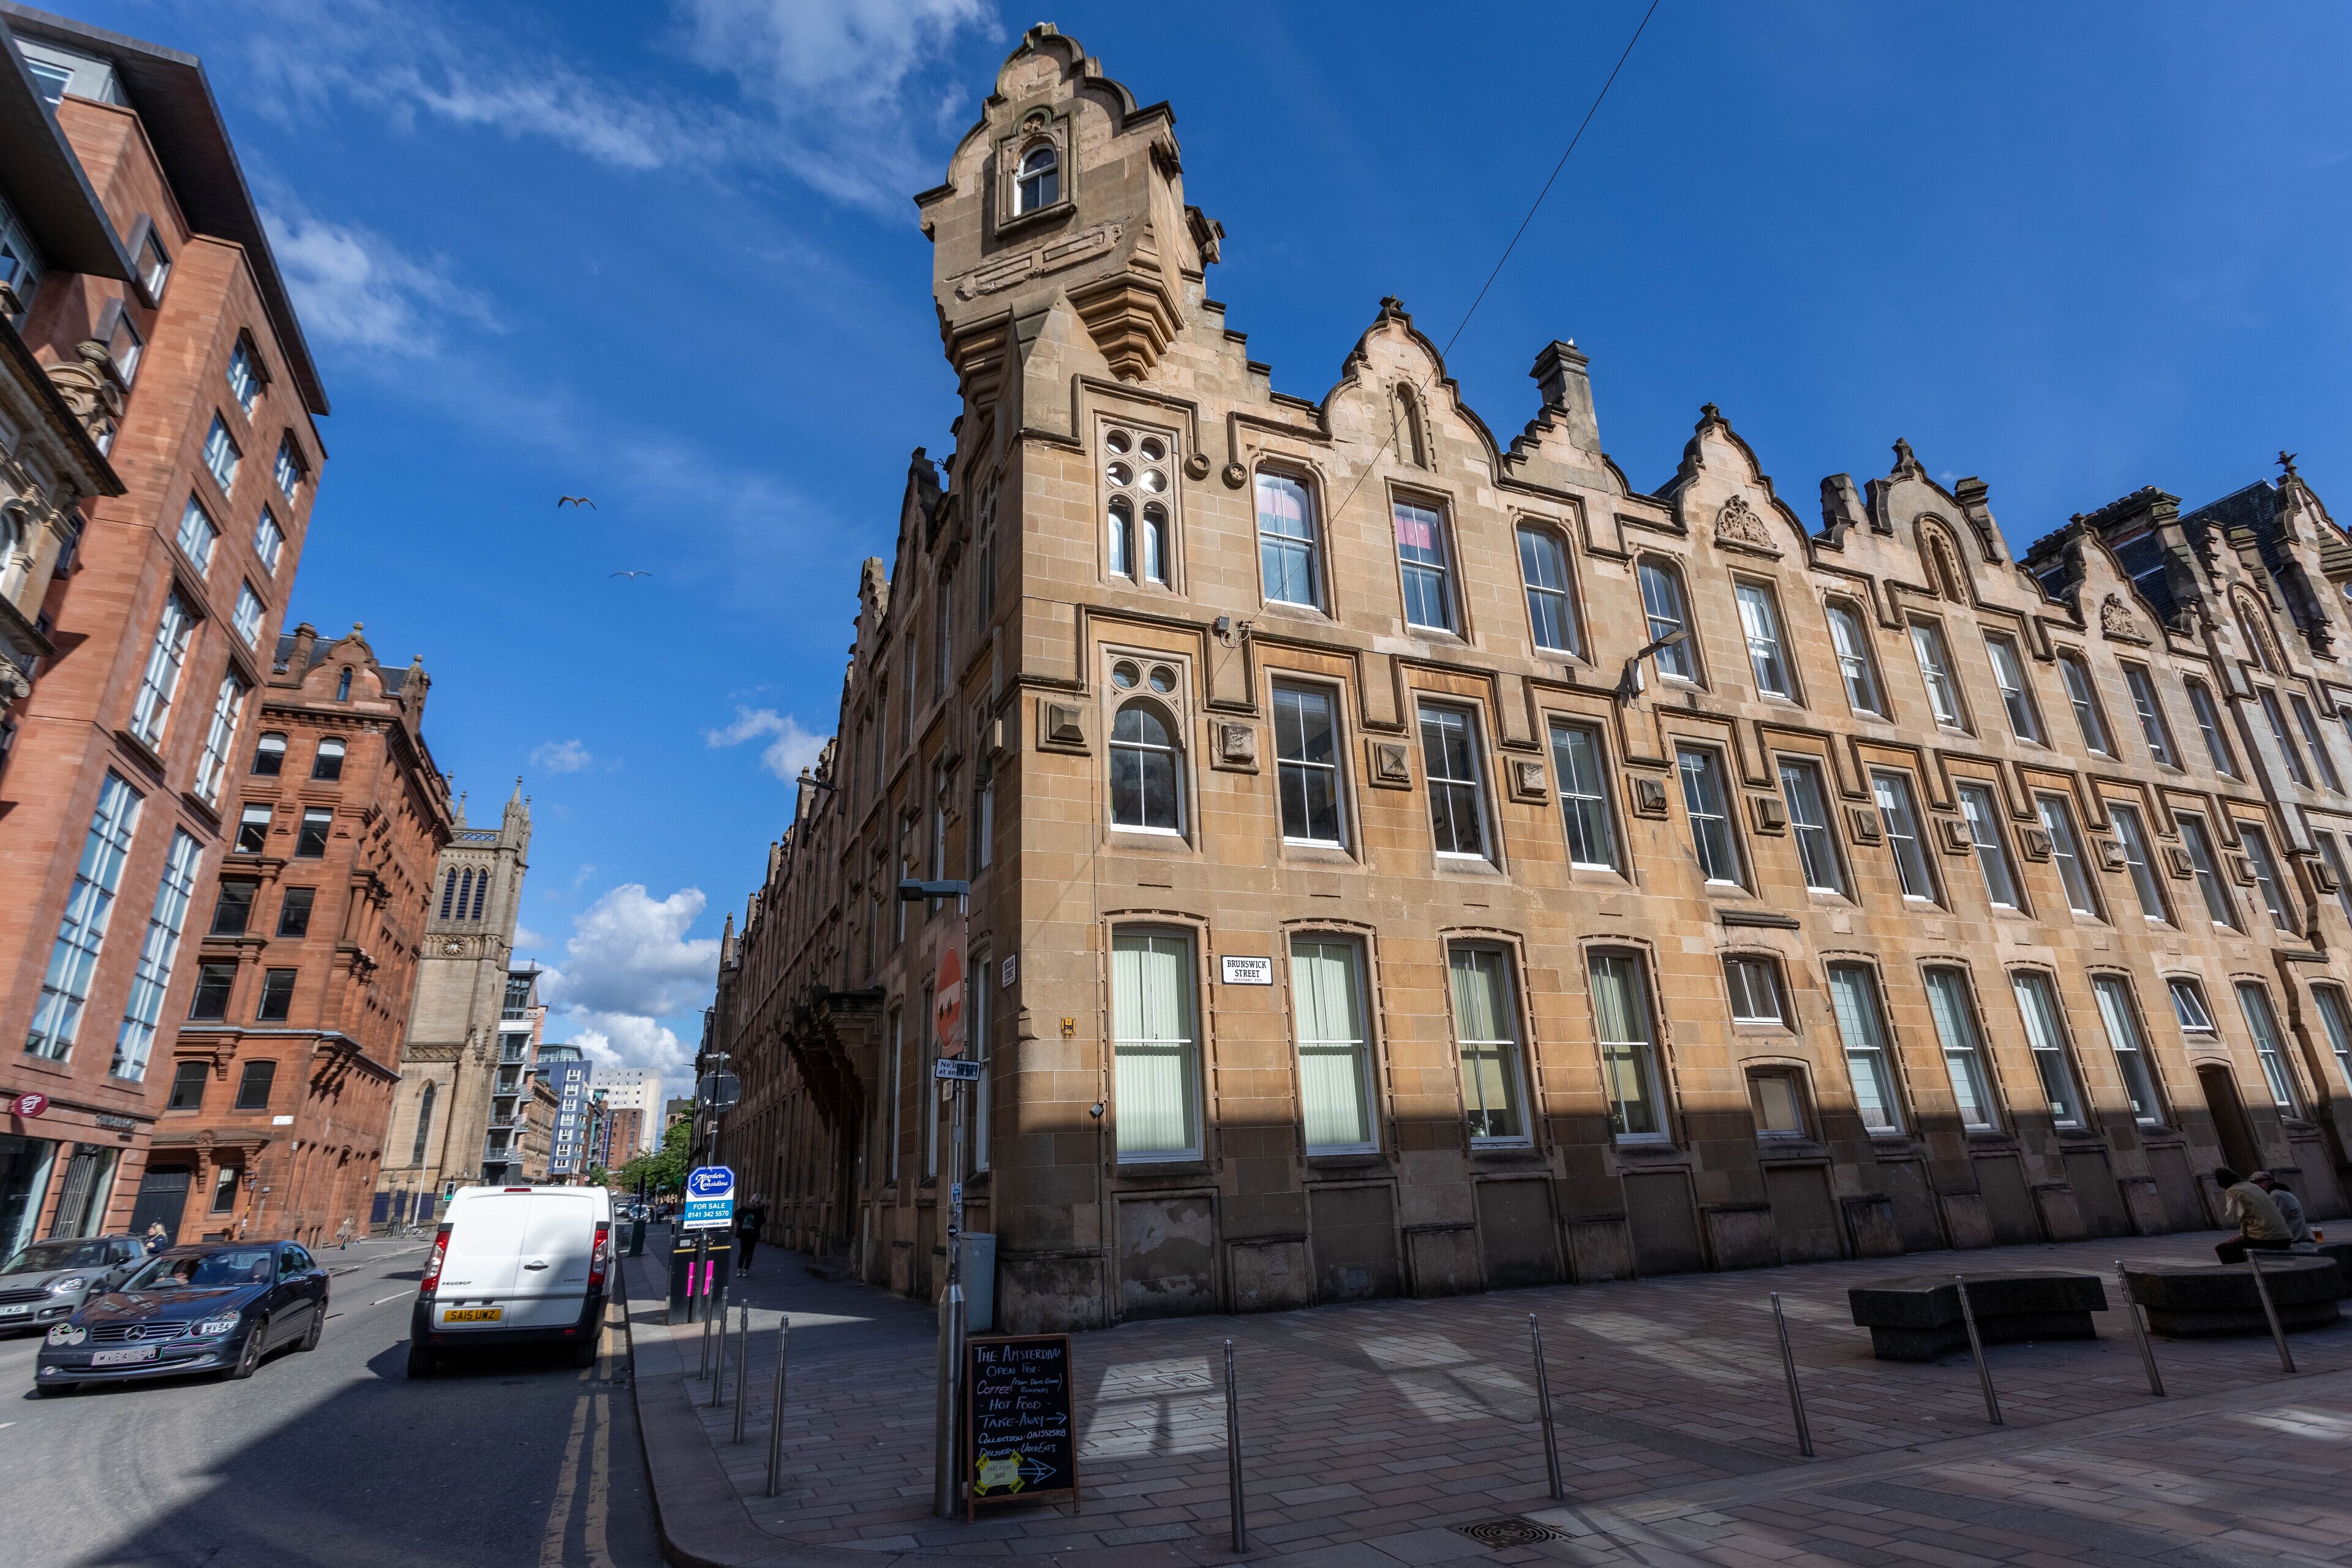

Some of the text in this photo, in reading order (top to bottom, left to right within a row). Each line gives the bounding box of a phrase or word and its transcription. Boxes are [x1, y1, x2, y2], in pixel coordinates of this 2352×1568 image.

[1227, 960, 1267, 968] BRUNSWICK
[692, 1172, 725, 1186] Aberdein
[700, 1178, 729, 1191] Considine
[450, 1310, 495, 1320] SA15 UWZ
[974, 1346, 998, 1363] THE
[987, 1366, 1016, 1376] OPEN
[977, 1380, 1011, 1394] COFFEE
[990, 1396, 1041, 1411] HOT FOOD
[979, 1433, 1025, 1444] COLLECTION:
